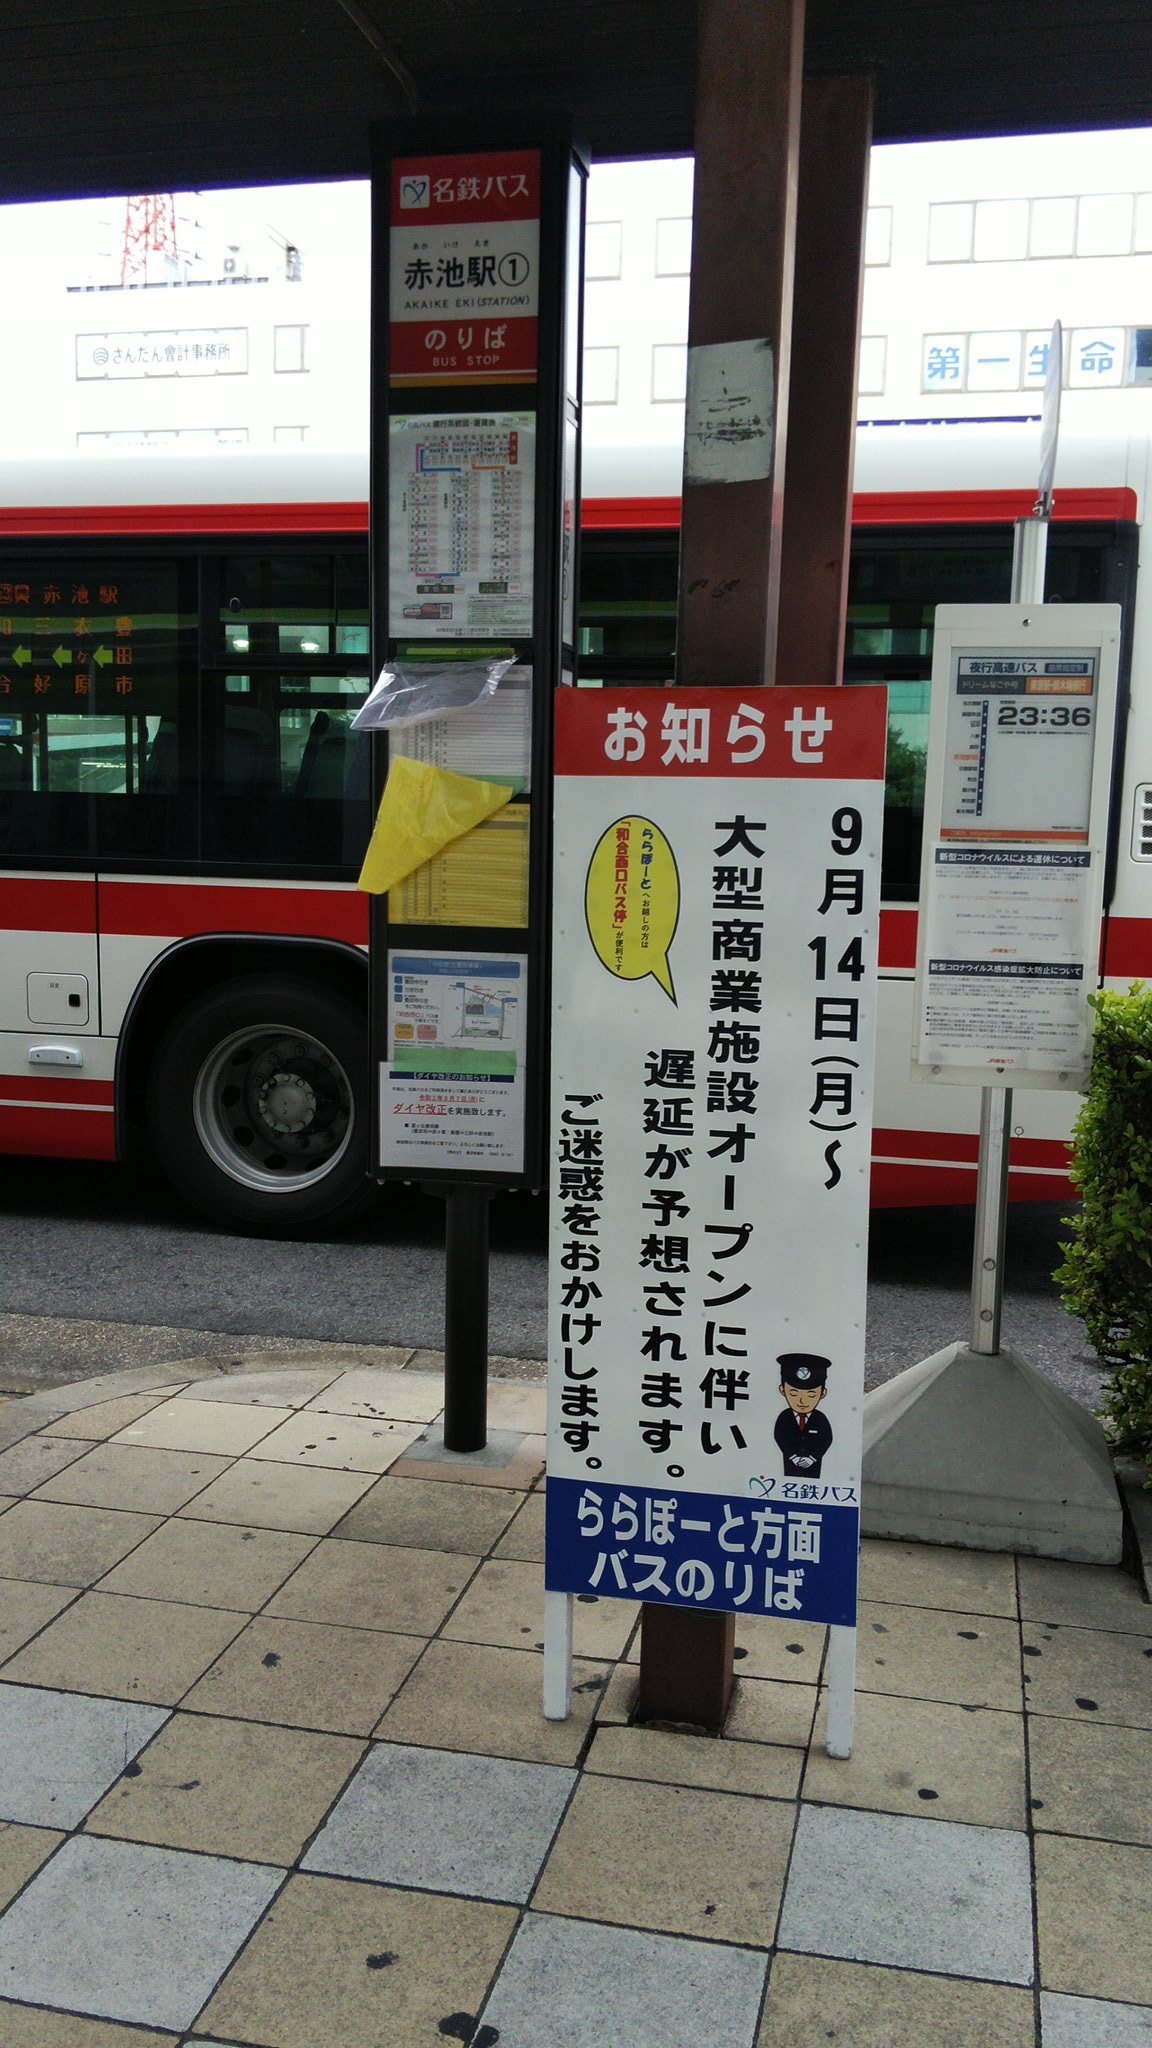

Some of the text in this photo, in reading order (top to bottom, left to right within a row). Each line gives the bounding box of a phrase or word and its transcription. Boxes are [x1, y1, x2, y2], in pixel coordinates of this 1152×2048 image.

[433, 174, 529, 203] 名鉄バス
[412, 242, 428, 250] あか
[405, 299, 448, 309] AKAIKE
[424, 324, 508, 350] のりば
[432, 355, 500, 367] BUS STOP
[969, 661, 1038, 674] 夜行高速バス
[997, 707, 1091, 726] 23:36
[604, 702, 833, 766] お知らせ
[699, 815, 767, 1455] 大型商業施設オープンに伴い
[638, 1049, 696, 1478] 遅延が予想されます。
[558, 1093, 604, 1470] ご迷惑をおかけします。
[780, 1482, 858, 1503] 名鉄バス
[577, 1488, 823, 1564] ららぽーと方面
[588, 1548, 805, 1611] バスのりば
